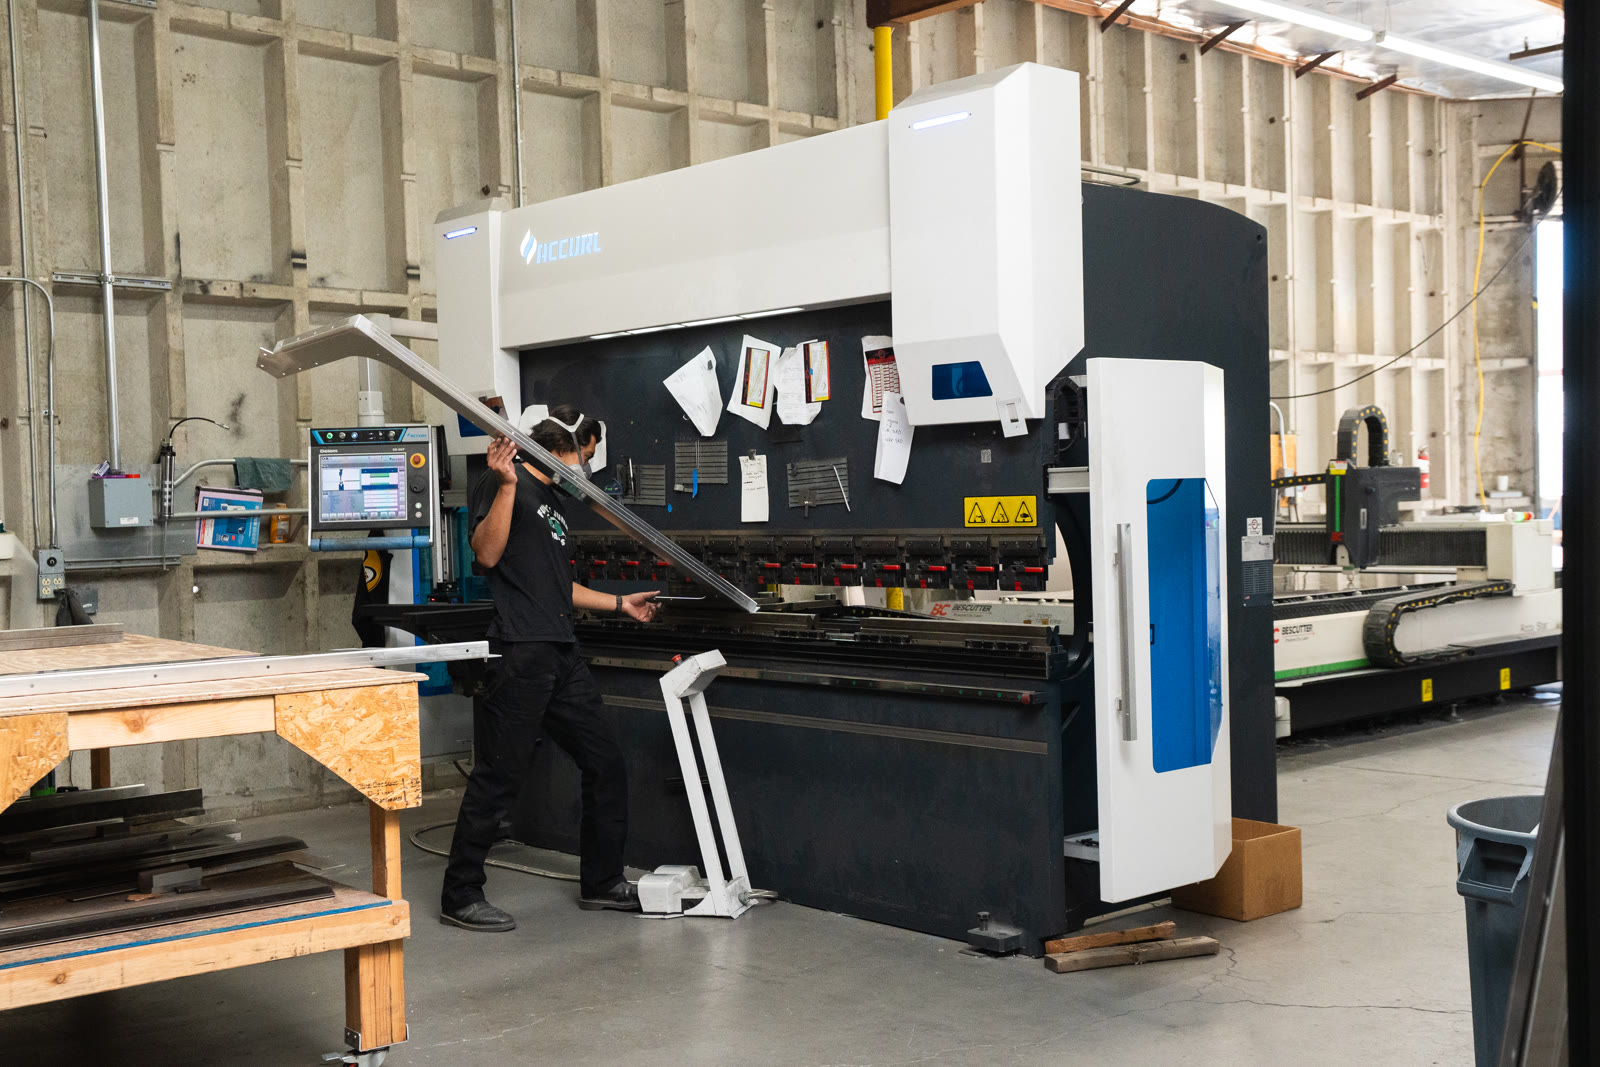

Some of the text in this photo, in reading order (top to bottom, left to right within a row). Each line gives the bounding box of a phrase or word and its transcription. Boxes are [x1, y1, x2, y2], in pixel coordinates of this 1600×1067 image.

[536, 232, 602, 264] ACCURL
[930, 603, 951, 616] BC
[952, 603, 992, 612] BESCUTTER
[1281, 623, 1313, 636] BESCUTTER
